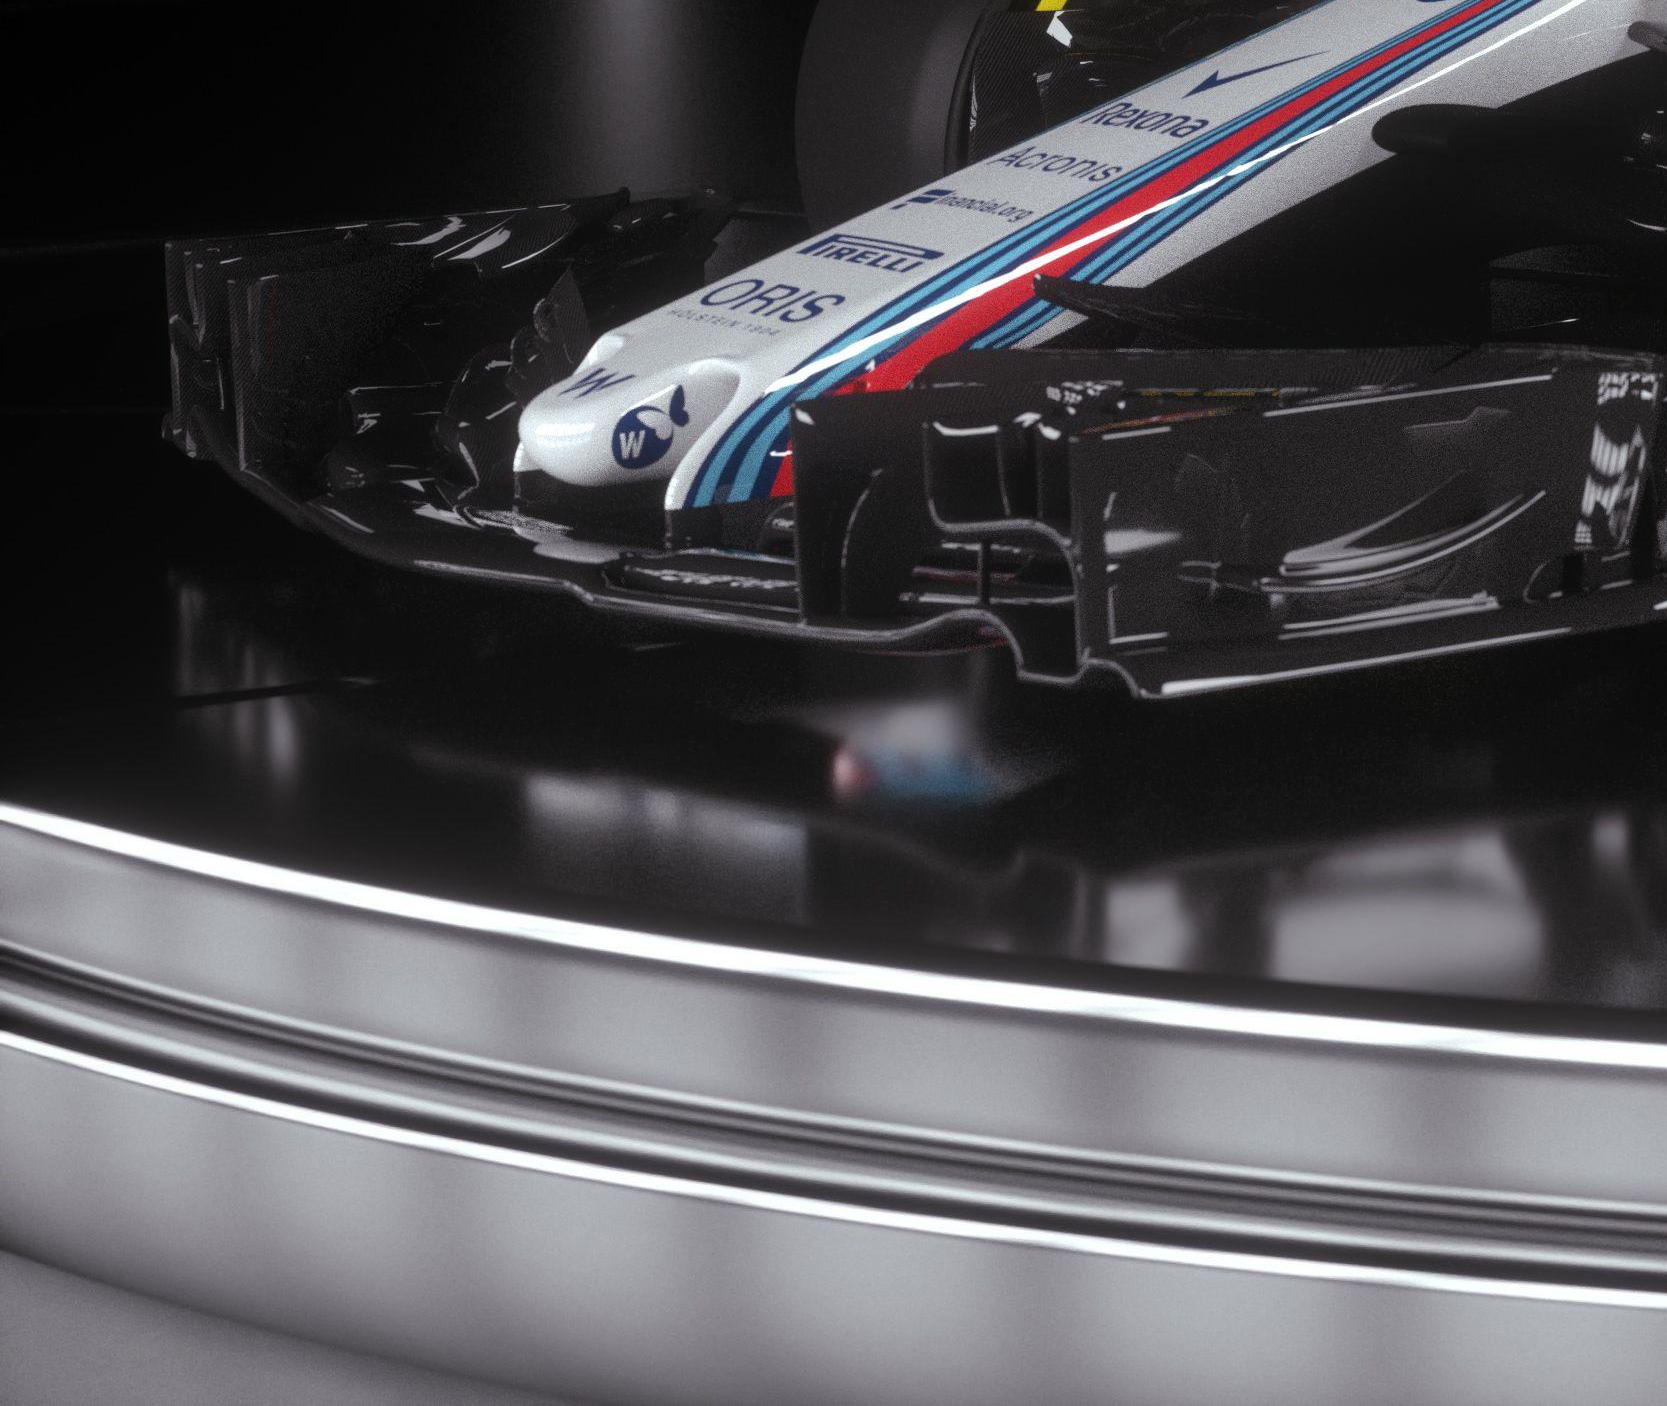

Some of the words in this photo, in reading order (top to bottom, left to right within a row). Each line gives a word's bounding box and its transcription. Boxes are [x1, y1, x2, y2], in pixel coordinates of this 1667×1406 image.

[1080, 101, 1210, 139] Rexona
[986, 146, 1123, 183] Acronis
[796, 233, 945, 273] PIRELLI
[700, 279, 846, 323] ORIS
[619, 429, 646, 460] W
